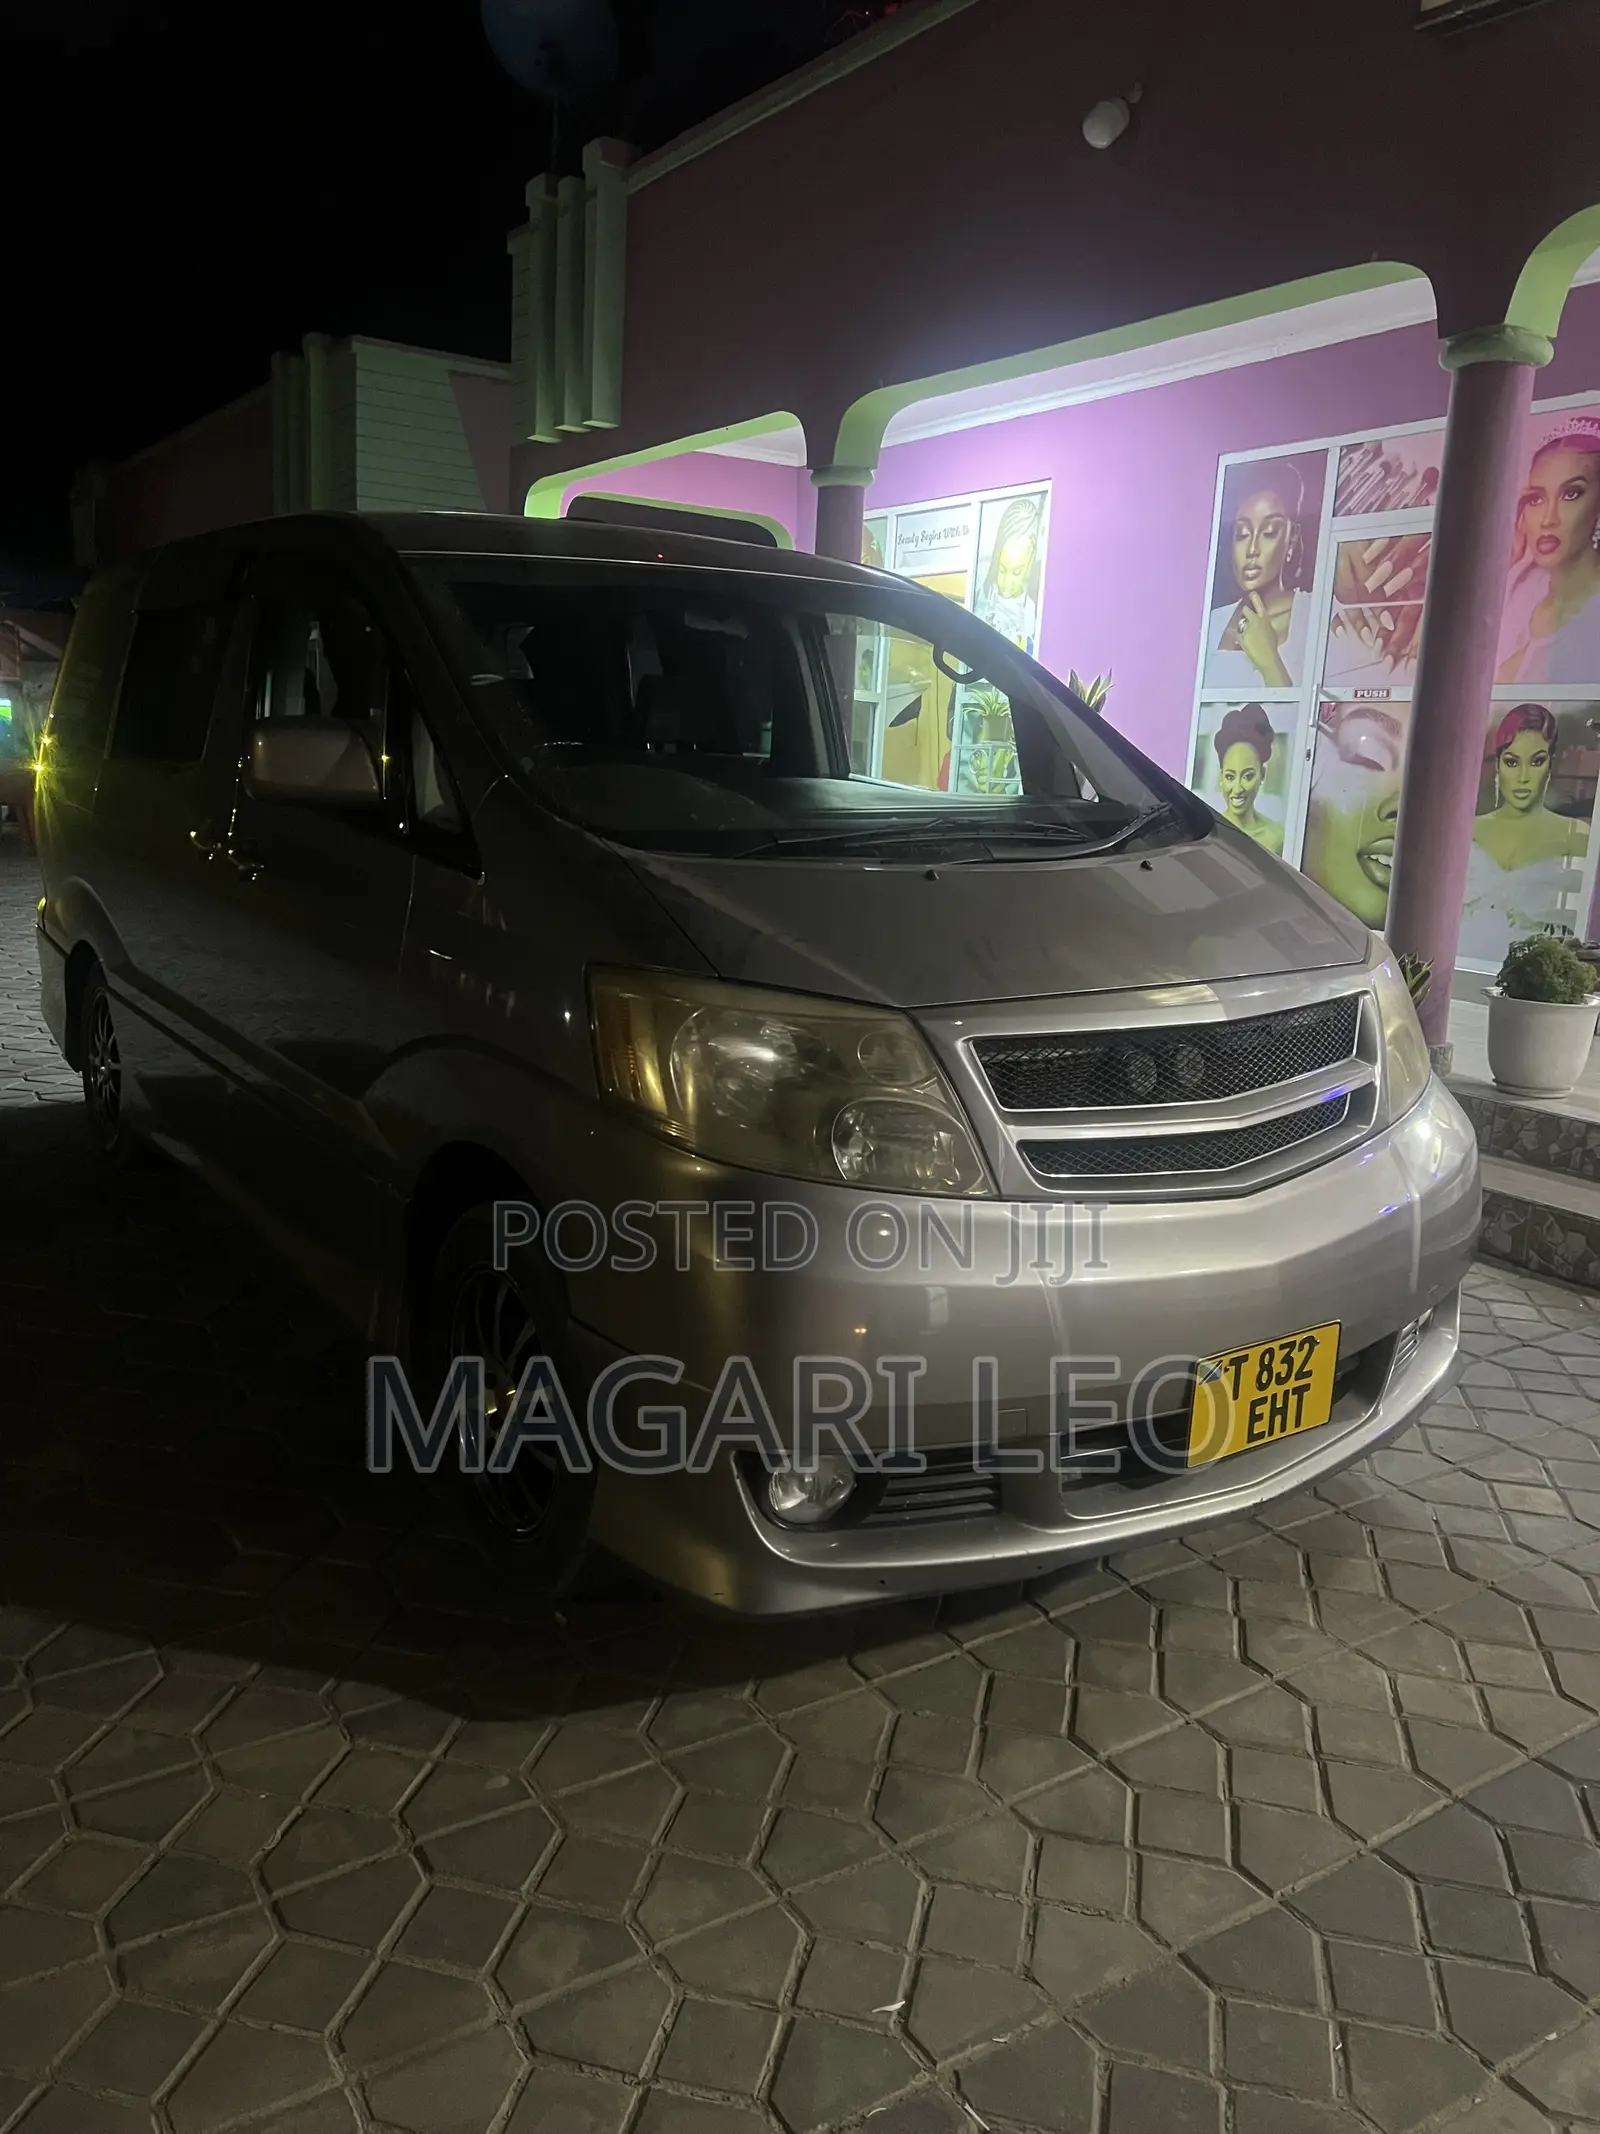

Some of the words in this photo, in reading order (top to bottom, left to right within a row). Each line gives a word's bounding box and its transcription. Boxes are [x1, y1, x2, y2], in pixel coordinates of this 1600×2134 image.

[920, 529, 942, 546] Begins
[1356, 689, 1388, 698] PUSH
[1228, 1353, 1250, 1401] T
[1256, 1335, 1320, 1392] 832
[1247, 1383, 1312, 1444] EHT
